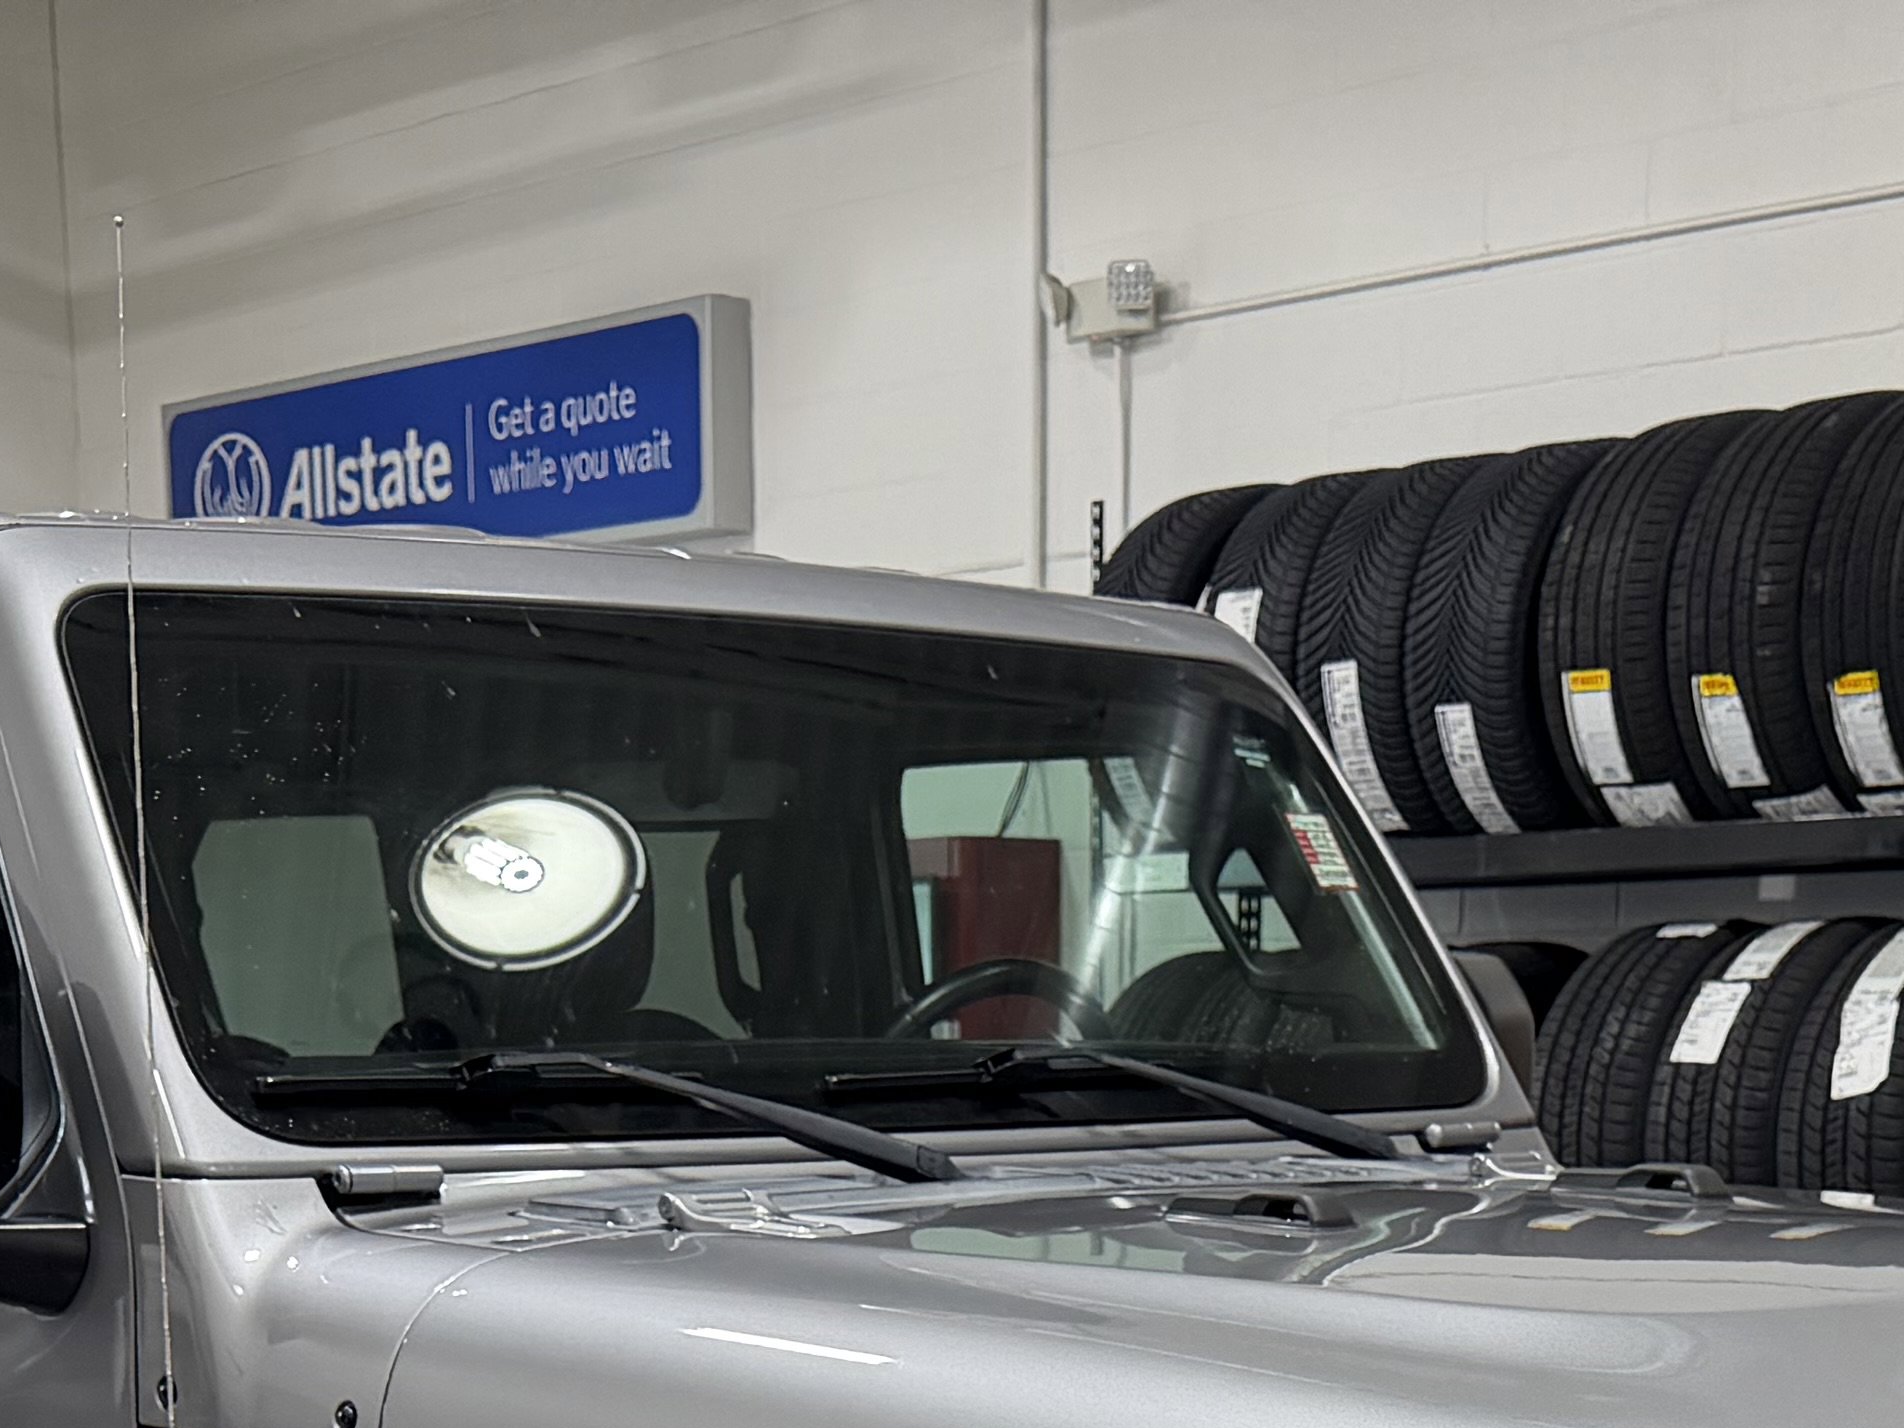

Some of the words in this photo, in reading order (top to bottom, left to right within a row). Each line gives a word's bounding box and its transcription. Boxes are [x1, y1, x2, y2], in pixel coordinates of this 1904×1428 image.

[488, 397, 537, 441] Get
[538, 406, 556, 432] a
[561, 380, 637, 437] quote
[280, 428, 453, 521] Allstate
[489, 447, 557, 495] while
[560, 446, 609, 495] you
[614, 427, 672, 475] wait
